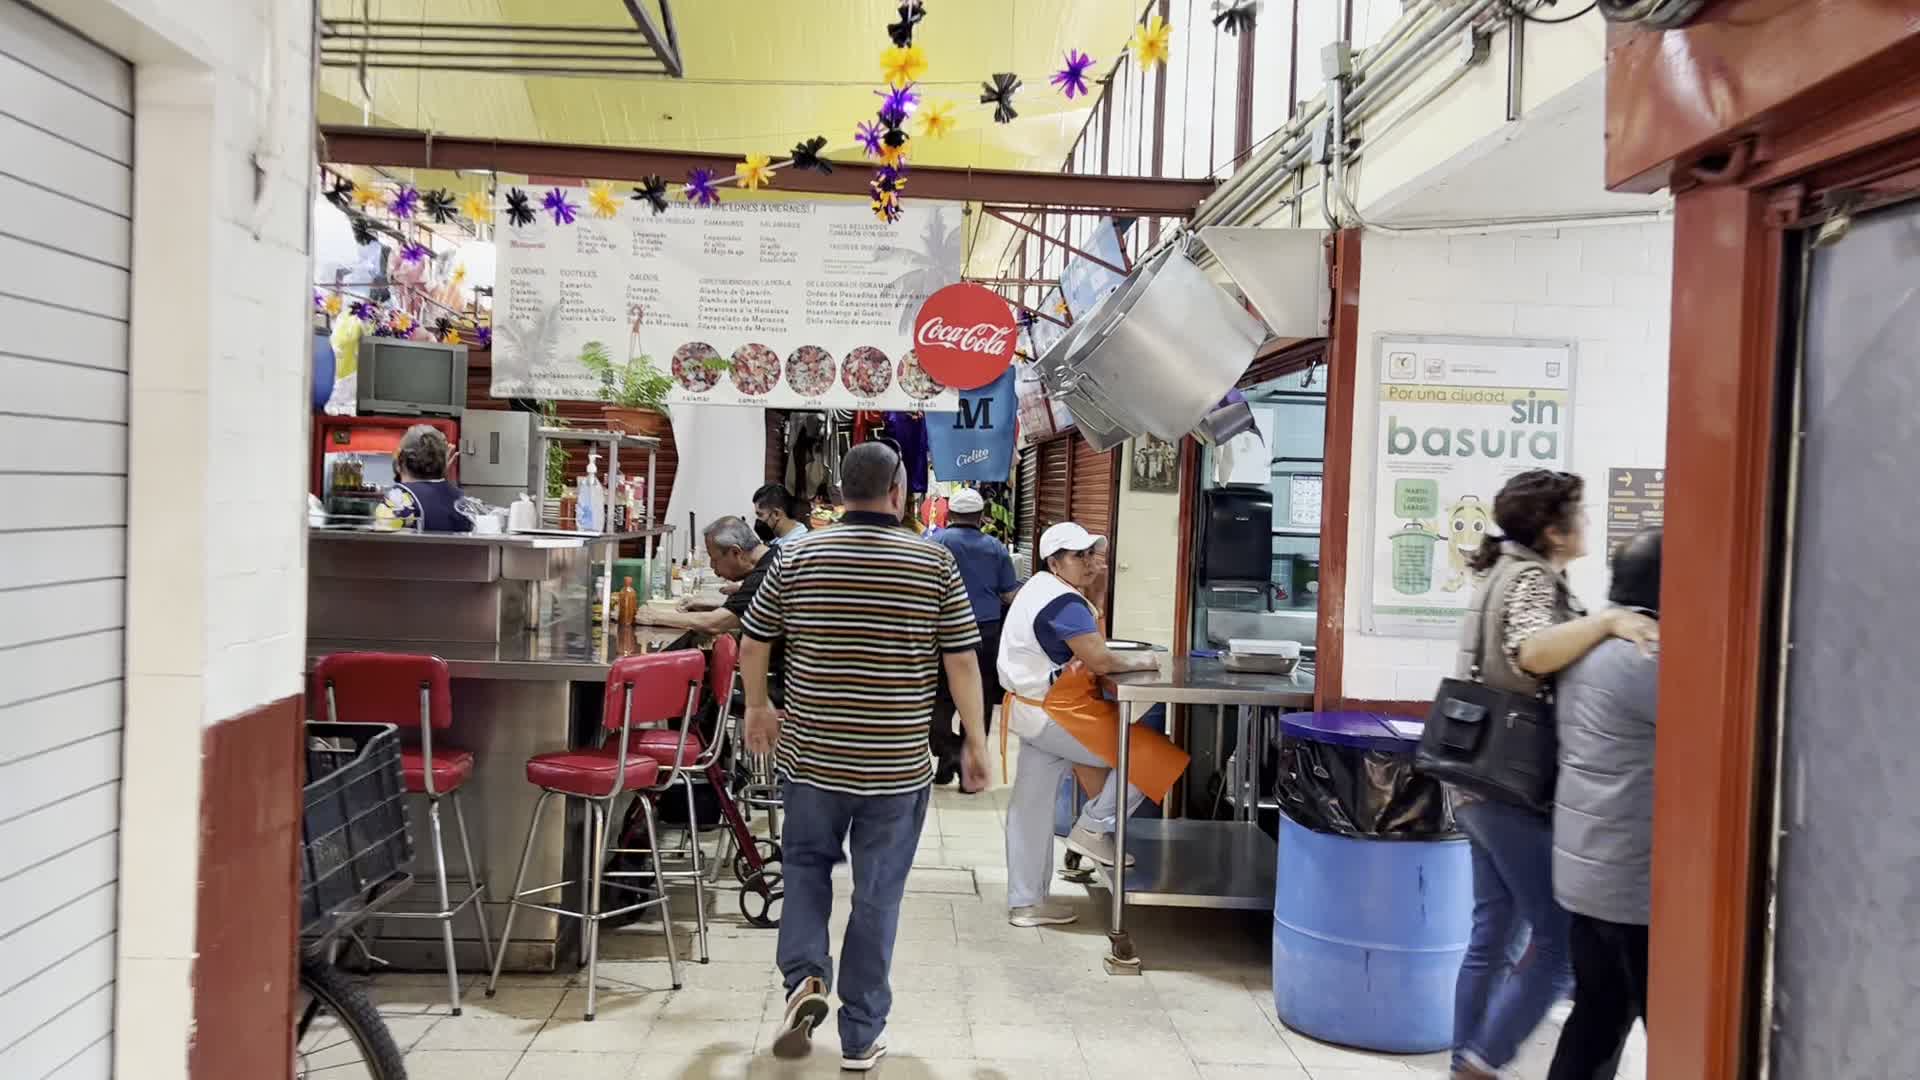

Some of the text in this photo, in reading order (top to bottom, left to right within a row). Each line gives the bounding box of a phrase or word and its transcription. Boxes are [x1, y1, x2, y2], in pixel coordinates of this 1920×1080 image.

[918, 316, 1014, 356] Coca-Cola
[1389, 387, 1505, 403] Por una ciudad
[1511, 391, 1559, 425] sin
[953, 398, 994, 429] M
[1387, 415, 1557, 460] basura
[956, 449, 990, 468] Cielito
